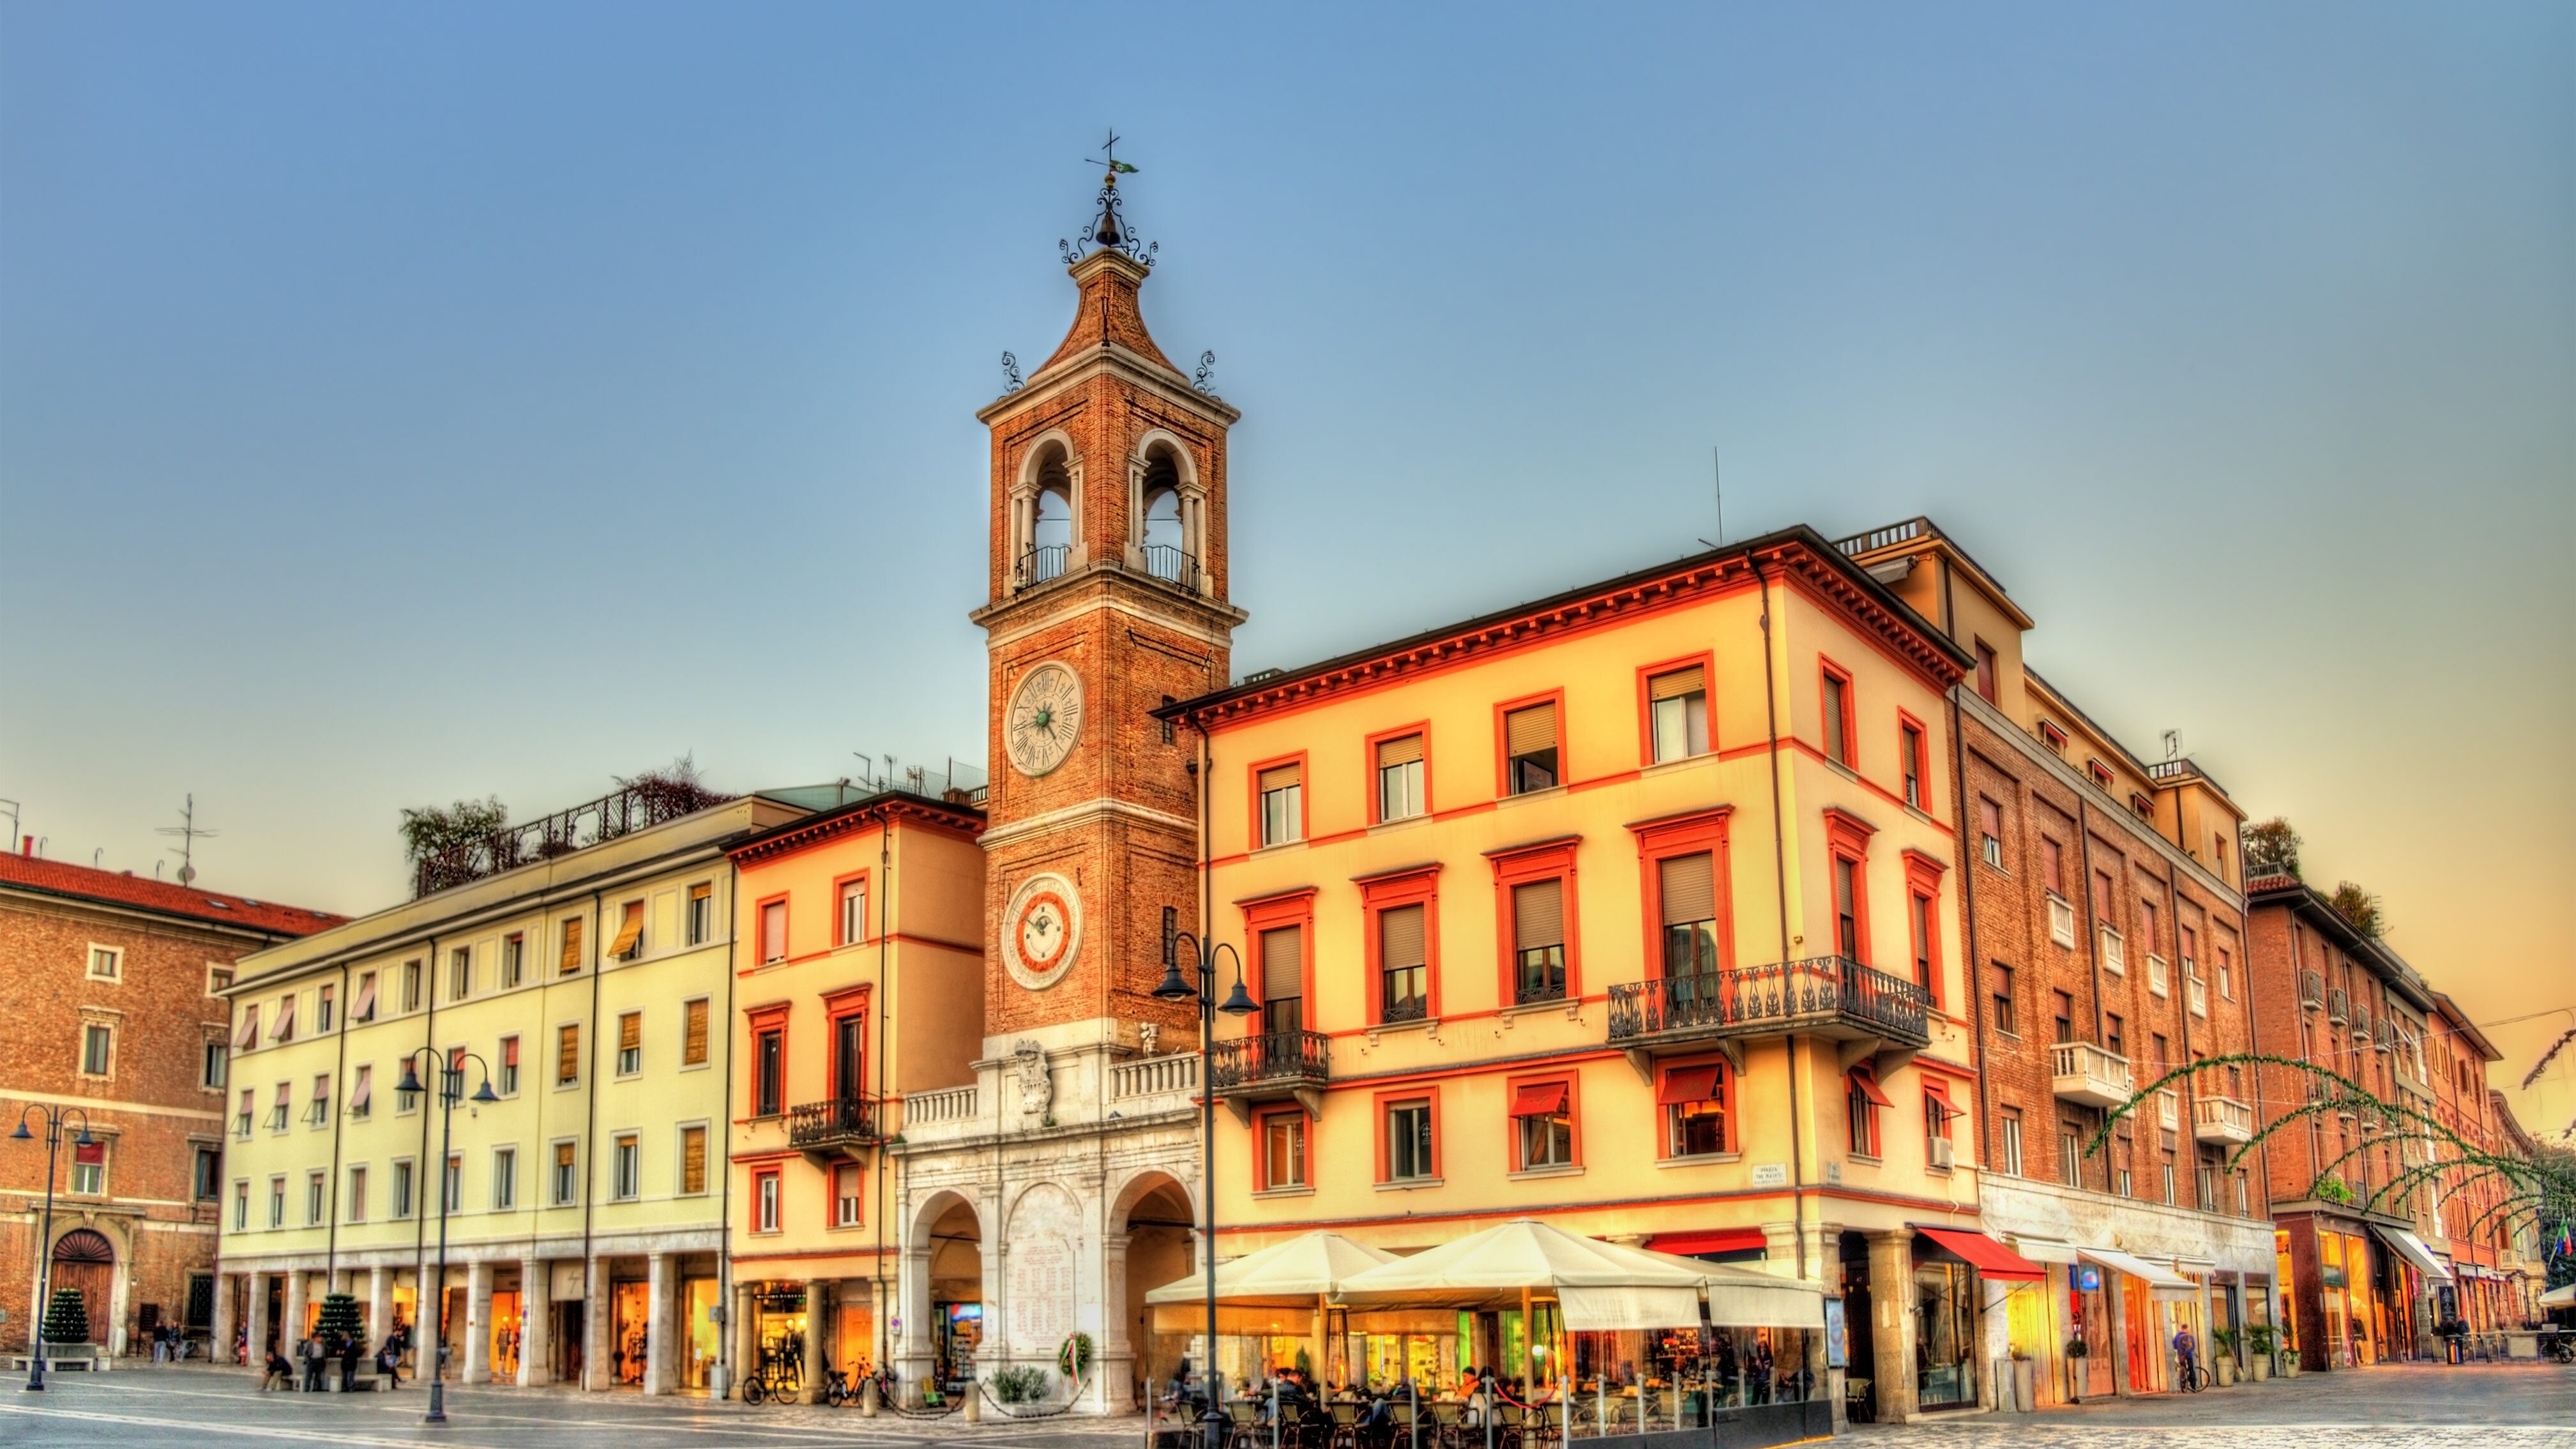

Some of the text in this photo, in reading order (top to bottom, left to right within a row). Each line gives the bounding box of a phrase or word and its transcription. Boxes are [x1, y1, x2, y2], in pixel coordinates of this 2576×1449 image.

[1061, 684, 1074, 701] II
[1017, 703, 1029, 713] X
[1064, 703, 1078, 716] III
